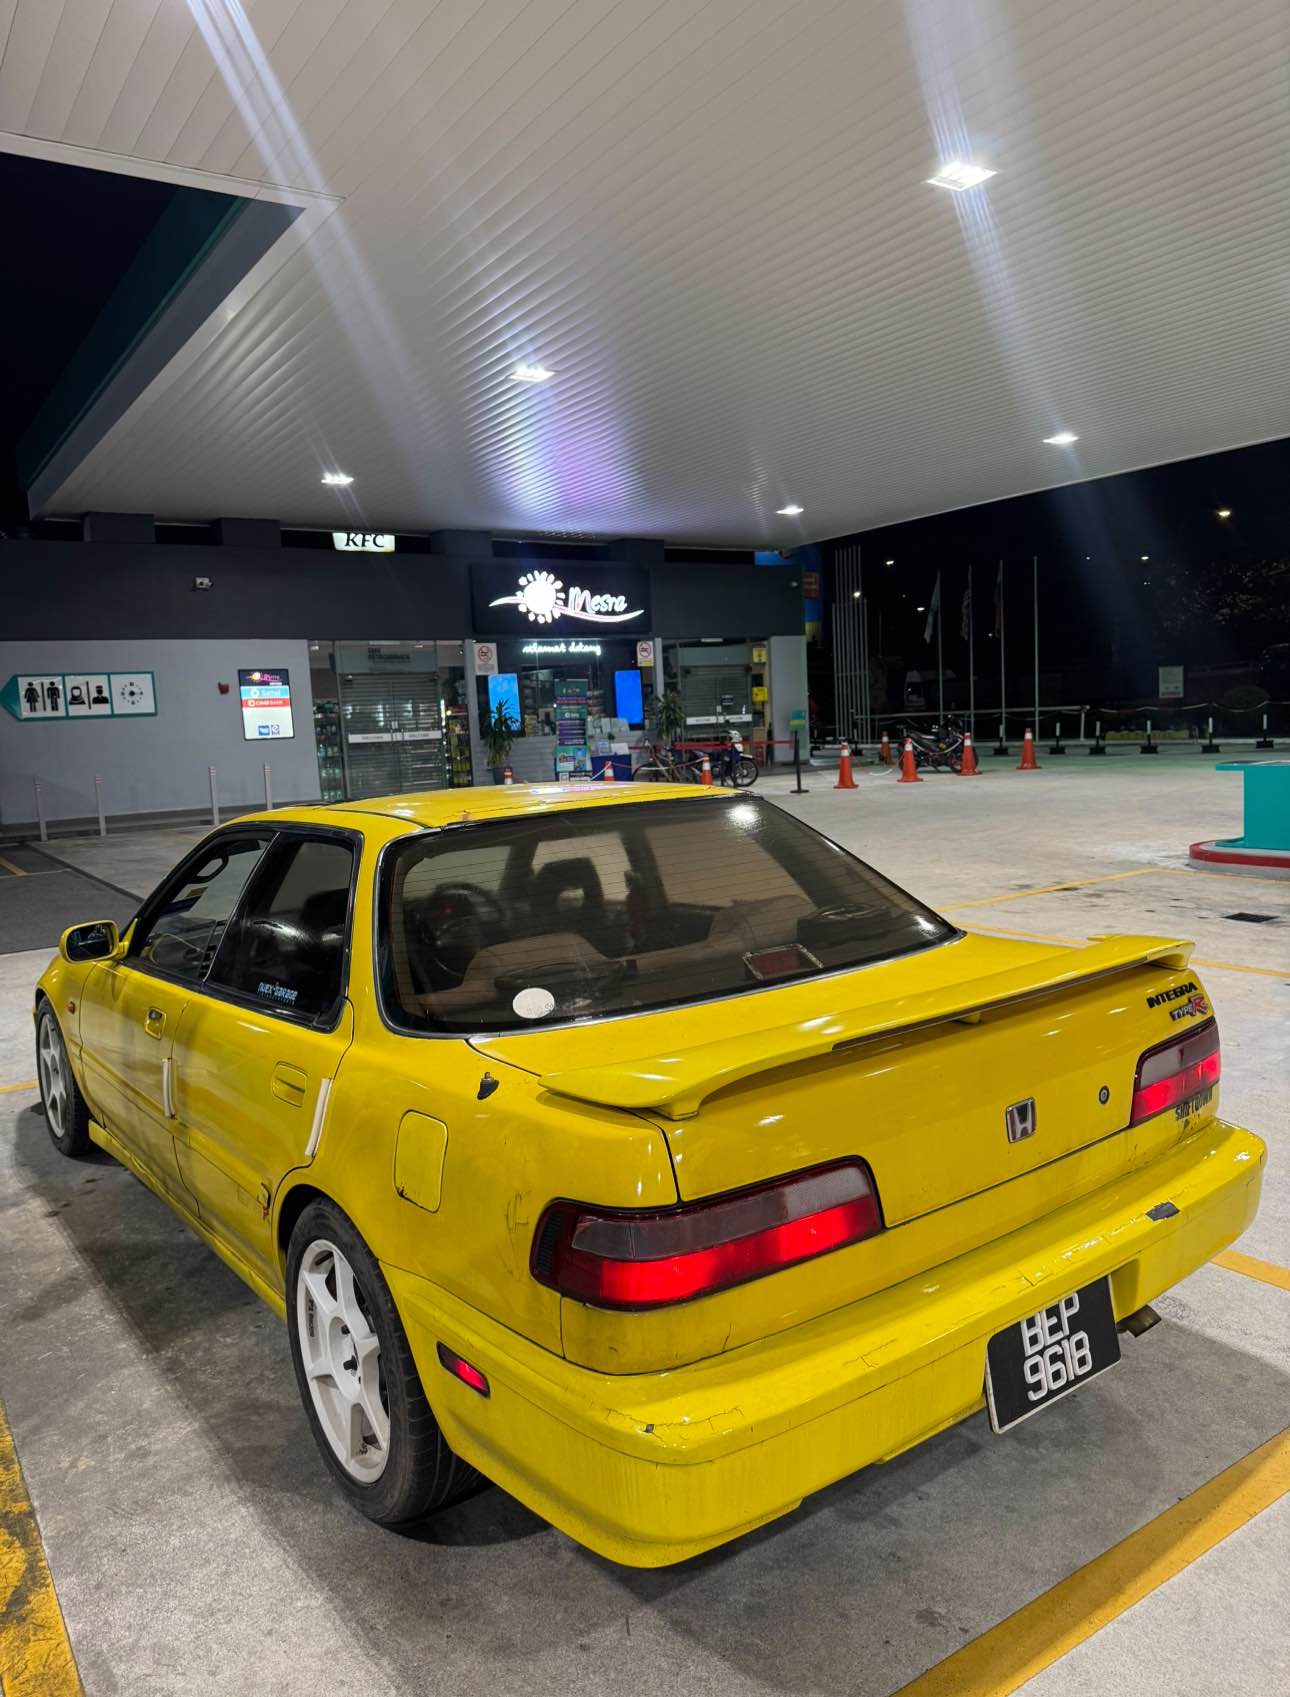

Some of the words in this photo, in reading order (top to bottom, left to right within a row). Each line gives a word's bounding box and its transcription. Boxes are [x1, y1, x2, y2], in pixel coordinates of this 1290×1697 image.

[344, 532, 385, 548] KFC
[567, 586, 628, 614] Mesra
[1146, 982, 1199, 1009] INTEGRA
[1020, 1292, 1080, 1358] BEP
[1023, 1330, 1092, 1401] 9618
